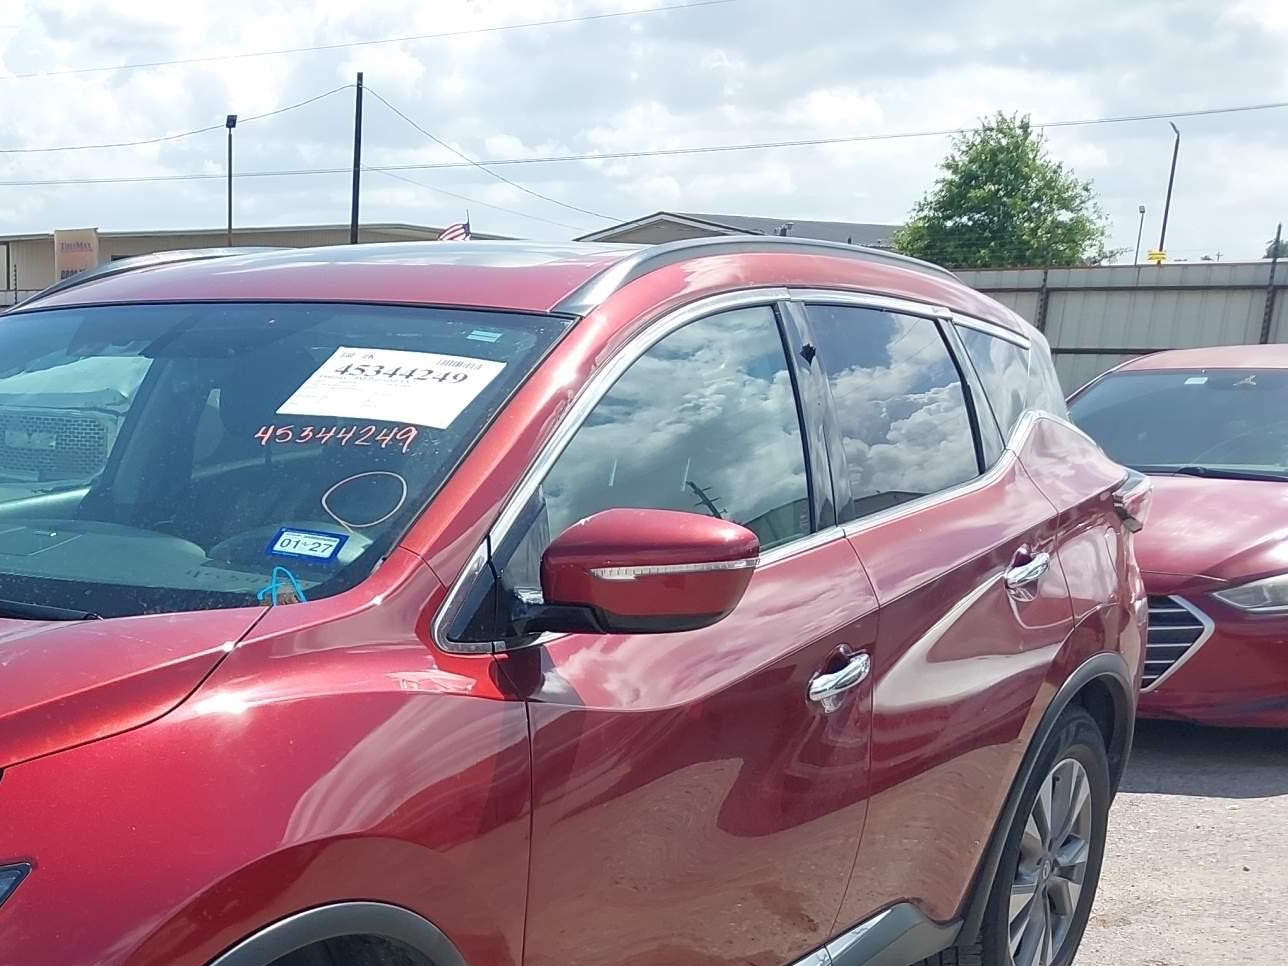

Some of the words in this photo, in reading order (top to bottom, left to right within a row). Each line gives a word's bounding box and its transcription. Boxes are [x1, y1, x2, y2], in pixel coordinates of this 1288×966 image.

[334, 363, 469, 384] 45344249
[254, 425, 418, 453] 45344249
[308, 541, 333, 553] 27
